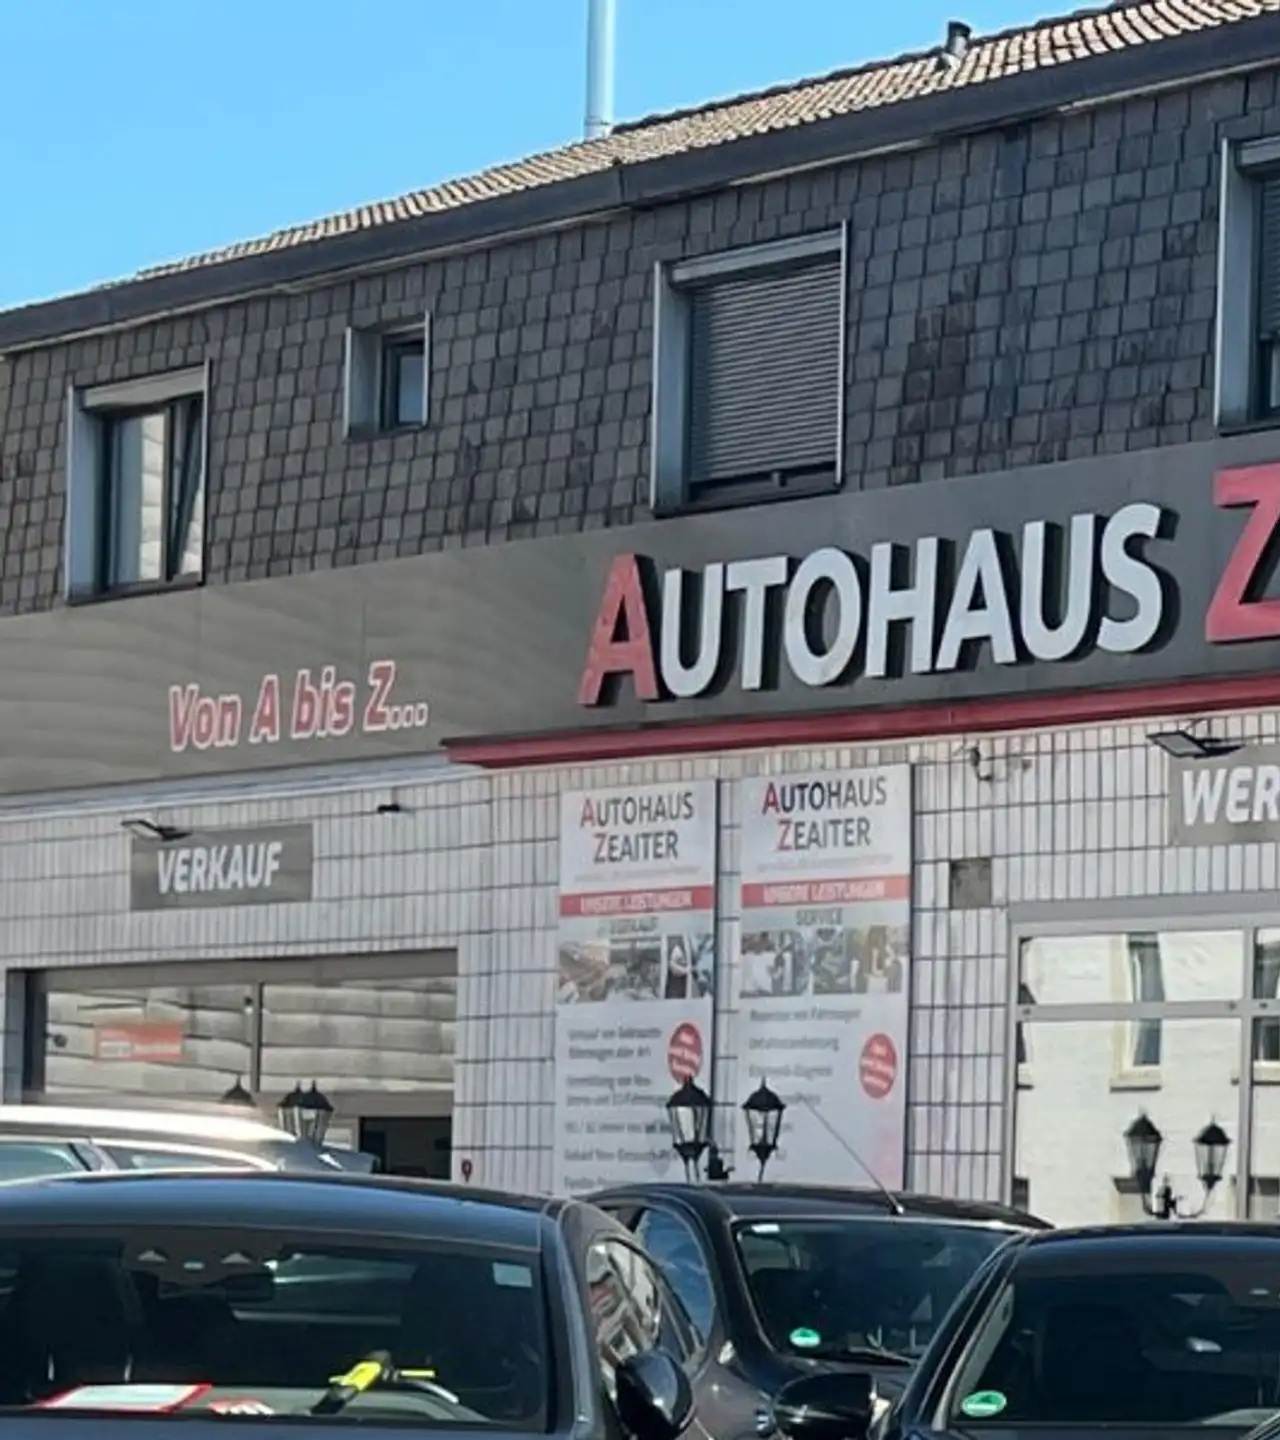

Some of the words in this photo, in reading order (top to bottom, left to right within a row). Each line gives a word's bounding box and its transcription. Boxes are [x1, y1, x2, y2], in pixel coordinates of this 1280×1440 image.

[576, 502, 1165, 706] AUTOHAUS
[169, 682, 241, 753] Von
[249, 674, 280, 744] A
[290, 667, 355, 740] bis
[580, 791, 694, 829] AUTOHAUS
[762, 775, 887, 815] AUTOHAUS
[593, 830, 679, 865] ZEAITER
[776, 817, 871, 852] ZEAITER
[155, 841, 282, 894] VERKAUF
